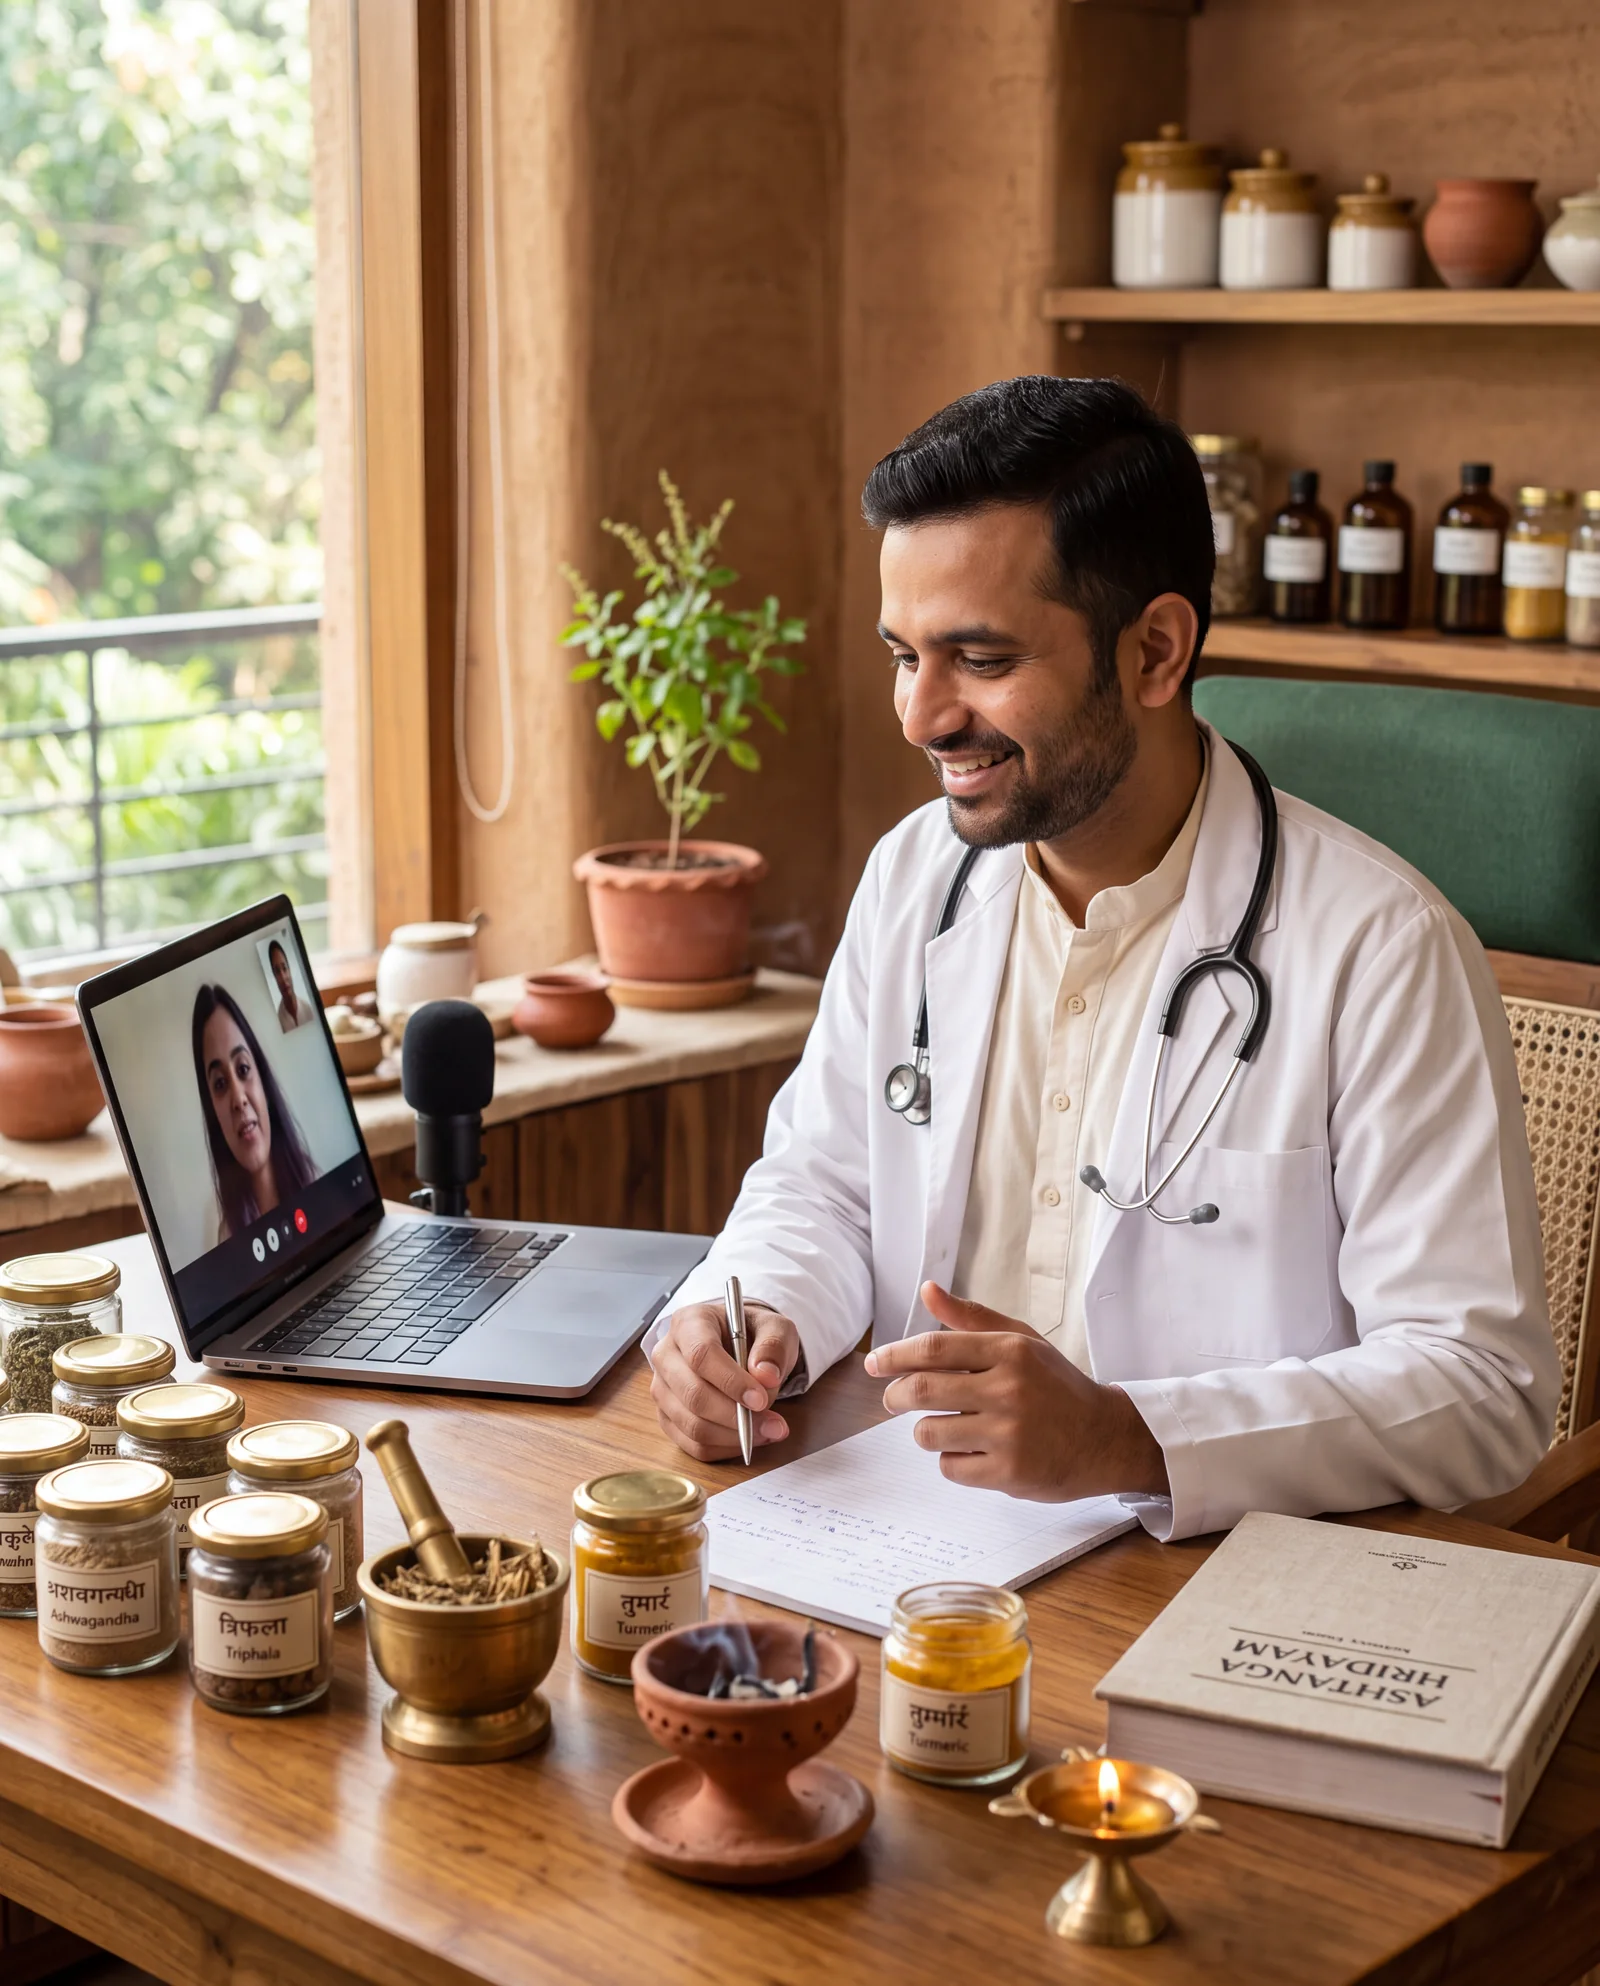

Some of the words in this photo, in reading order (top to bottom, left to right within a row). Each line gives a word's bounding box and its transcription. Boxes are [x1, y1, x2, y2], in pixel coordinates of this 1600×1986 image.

[51, 1608, 140, 1630] Ashwagandha
[219, 1611, 289, 1638] त्रिफला
[225, 1645, 281, 1664] Triphala
[1232, 1638, 1450, 1690] HRIDAYAM
[1220, 1657, 1442, 1709] ASHTANGA
[908, 1731, 970, 1754] Turmeric
